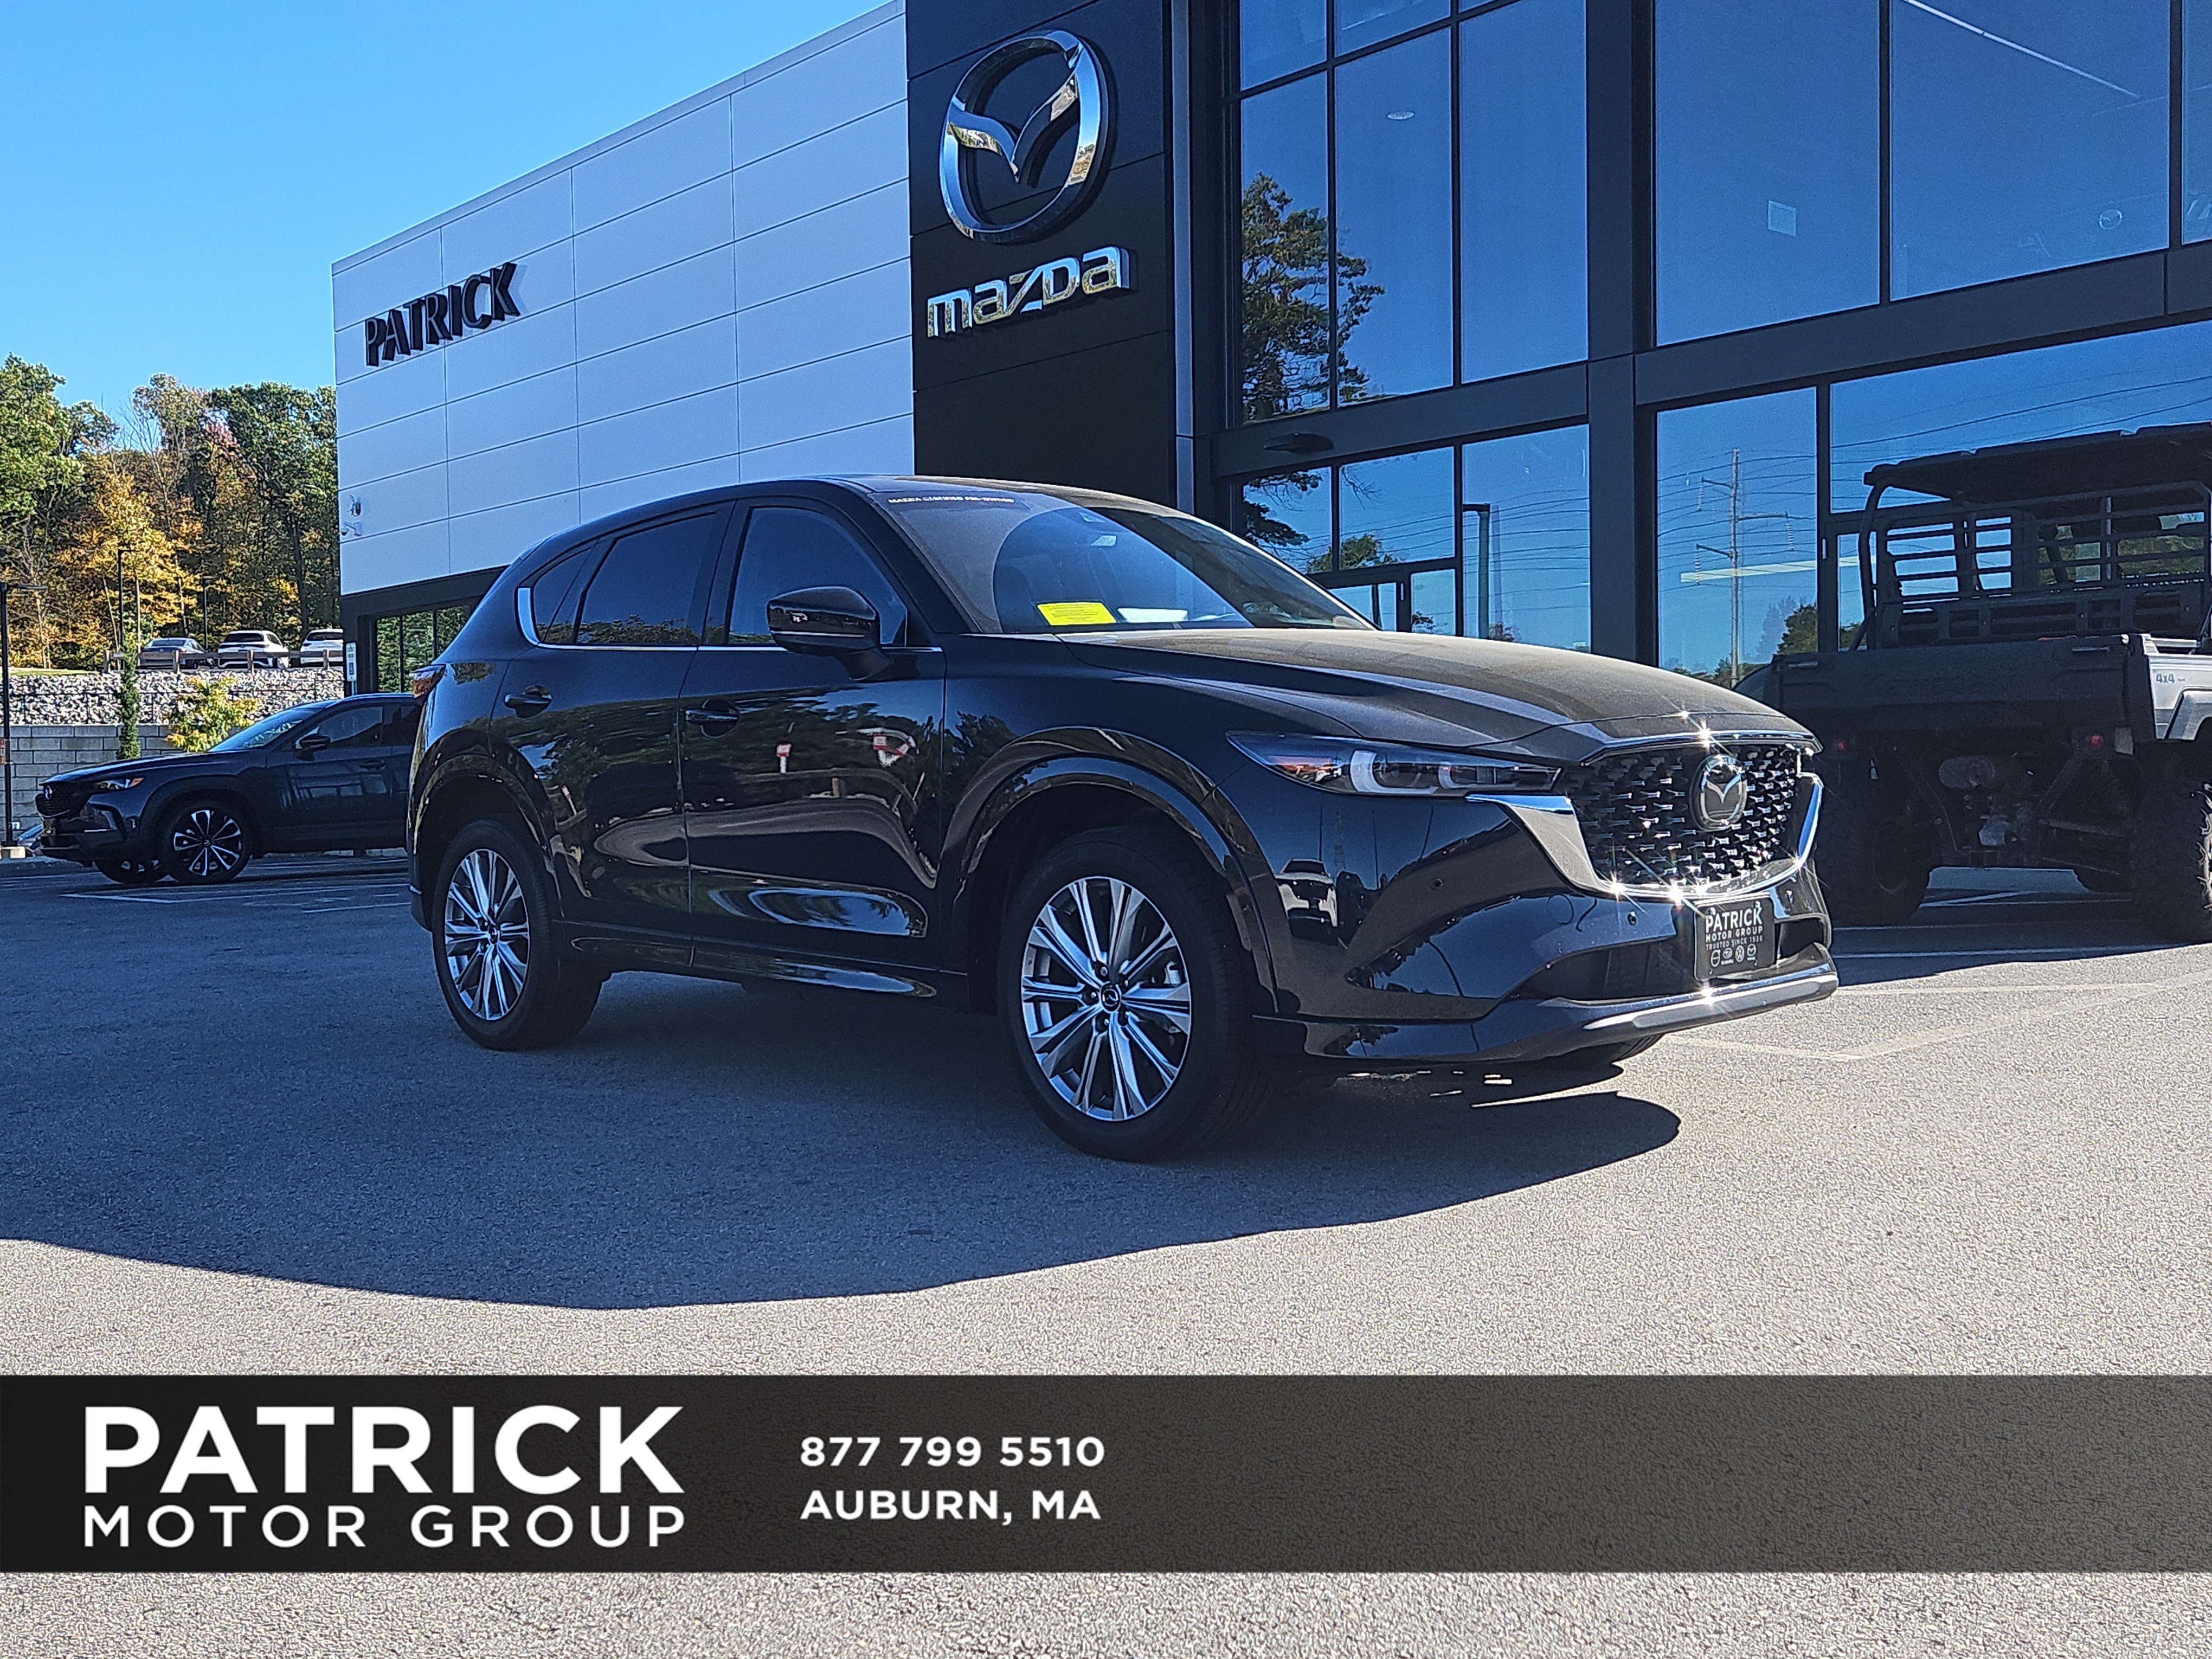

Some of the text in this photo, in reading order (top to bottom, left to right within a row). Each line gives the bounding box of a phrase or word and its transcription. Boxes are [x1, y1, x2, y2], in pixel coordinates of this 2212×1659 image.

[365, 262, 521, 367] PATRICK
[2156, 673, 2175, 684] 4x4
[1706, 907, 1763, 933] PATRICK
[1706, 925, 1763, 943] MOTOR GROUP
[1706, 941, 1729, 950] TRUSTED
